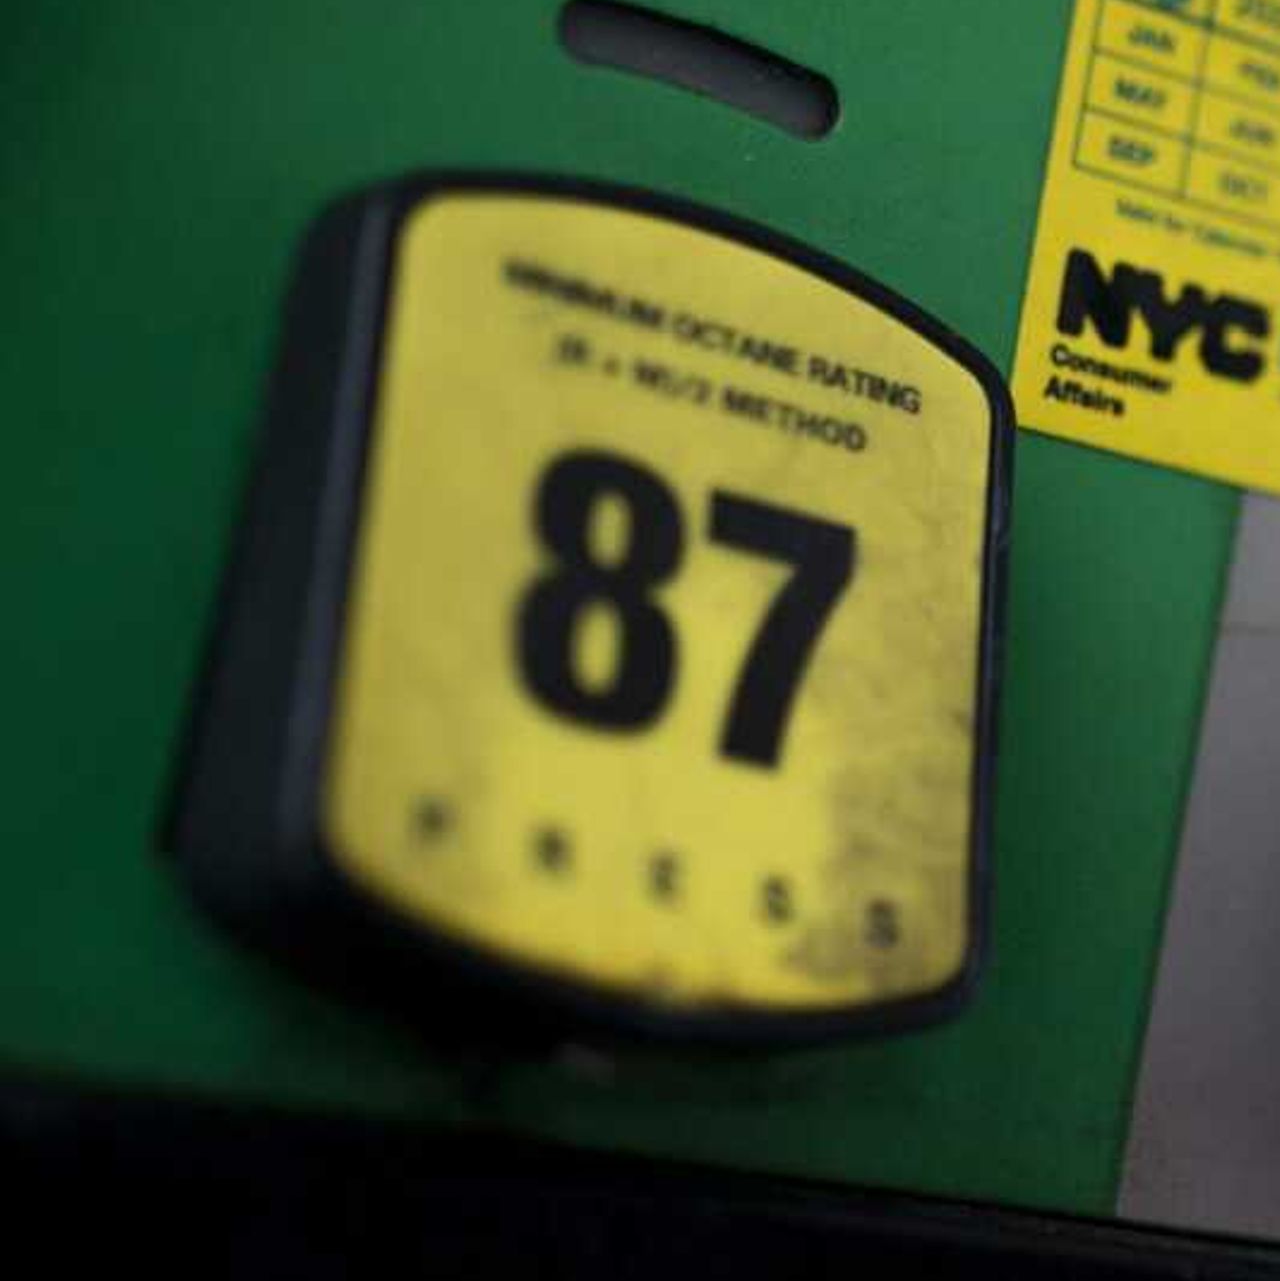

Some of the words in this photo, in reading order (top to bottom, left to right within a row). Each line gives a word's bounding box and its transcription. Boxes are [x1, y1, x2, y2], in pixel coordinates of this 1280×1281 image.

[1056, 247, 1270, 384] NYC
[672, 309, 802, 373] OCTANE
[808, 355, 923, 417] RATING
[1043, 374, 1127, 418] Affairs
[1049, 343, 1174, 396] Consumer
[720, 384, 868, 454] METHOD
[511, 447, 858, 773] 87
